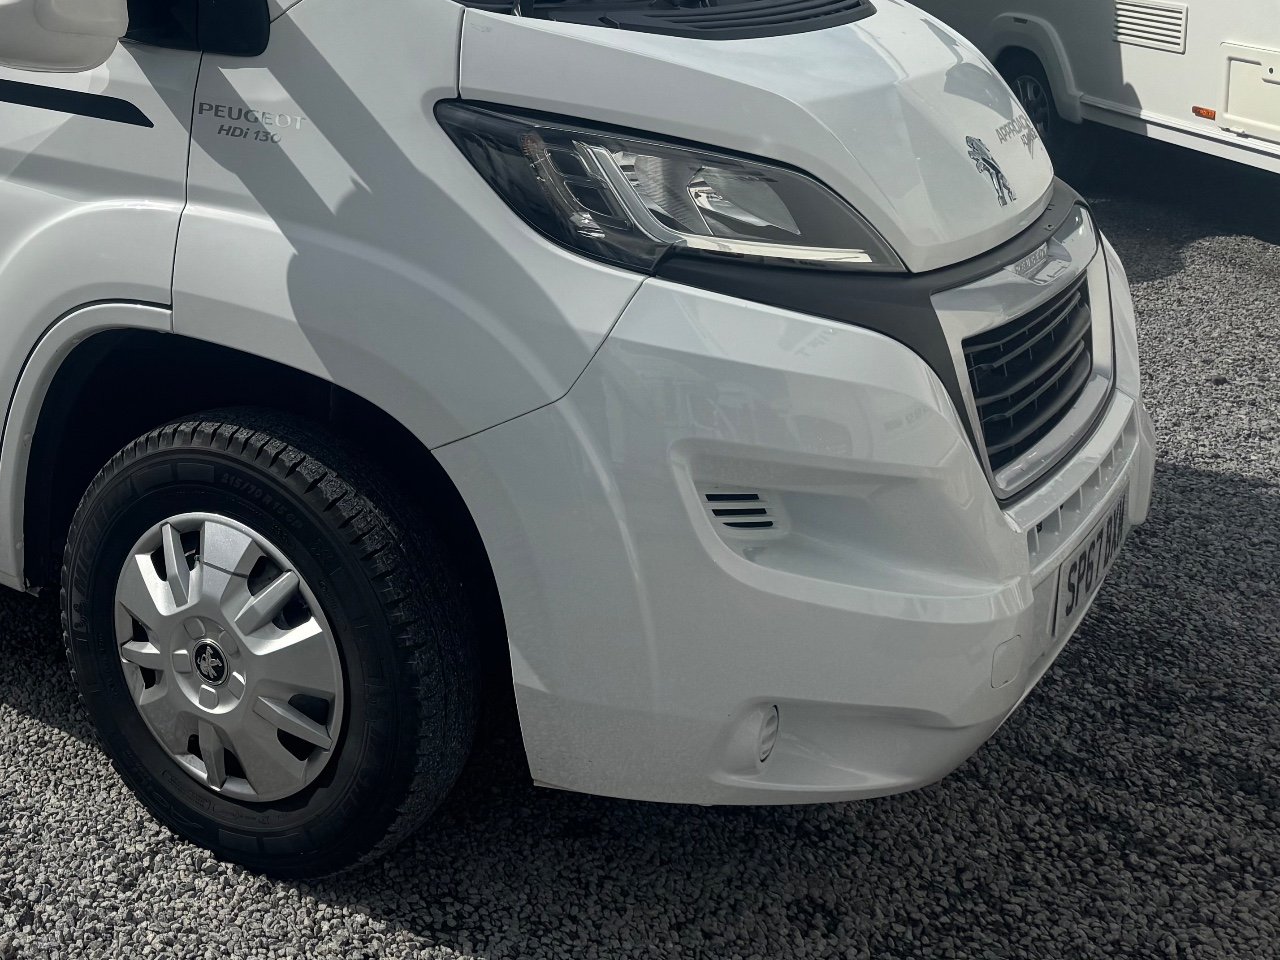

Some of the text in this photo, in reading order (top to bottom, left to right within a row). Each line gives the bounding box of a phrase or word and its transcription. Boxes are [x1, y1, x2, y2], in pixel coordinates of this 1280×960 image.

[198, 102, 306, 130] PEUGEOT
[217, 124, 282, 143] HDi 130
[1065, 527, 1104, 617] SP67
